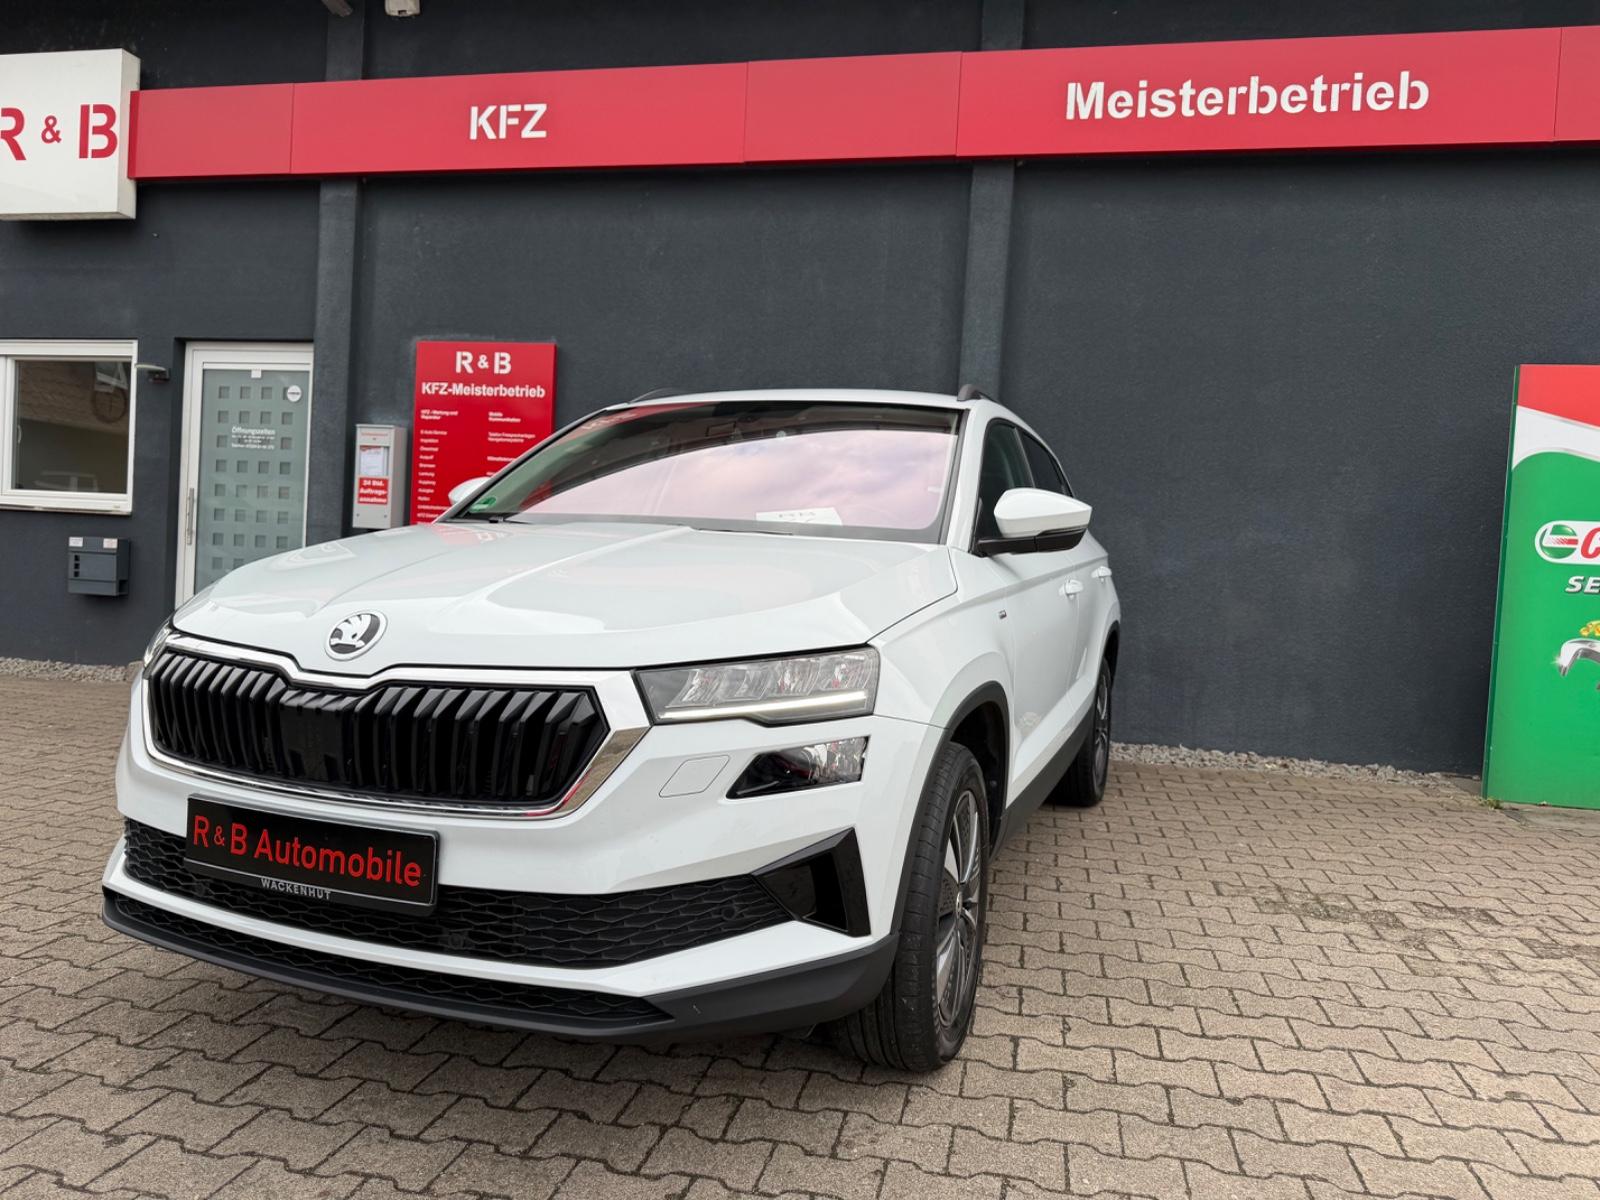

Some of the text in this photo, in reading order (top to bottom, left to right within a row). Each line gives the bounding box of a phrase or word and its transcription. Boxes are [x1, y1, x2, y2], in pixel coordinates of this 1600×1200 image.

[1066, 71, 1430, 120] Meisterbetrieb
[0, 104, 118, 161] R & B
[469, 103, 548, 140] KFZ
[455, 351, 512, 375] R & B
[421, 381, 546, 399] KFZ-Meisterbetrieb
[1564, 575, 1600, 595] SE
[193, 815, 422, 887] R & B Automobile
[260, 877, 332, 900] WACKENHUT
